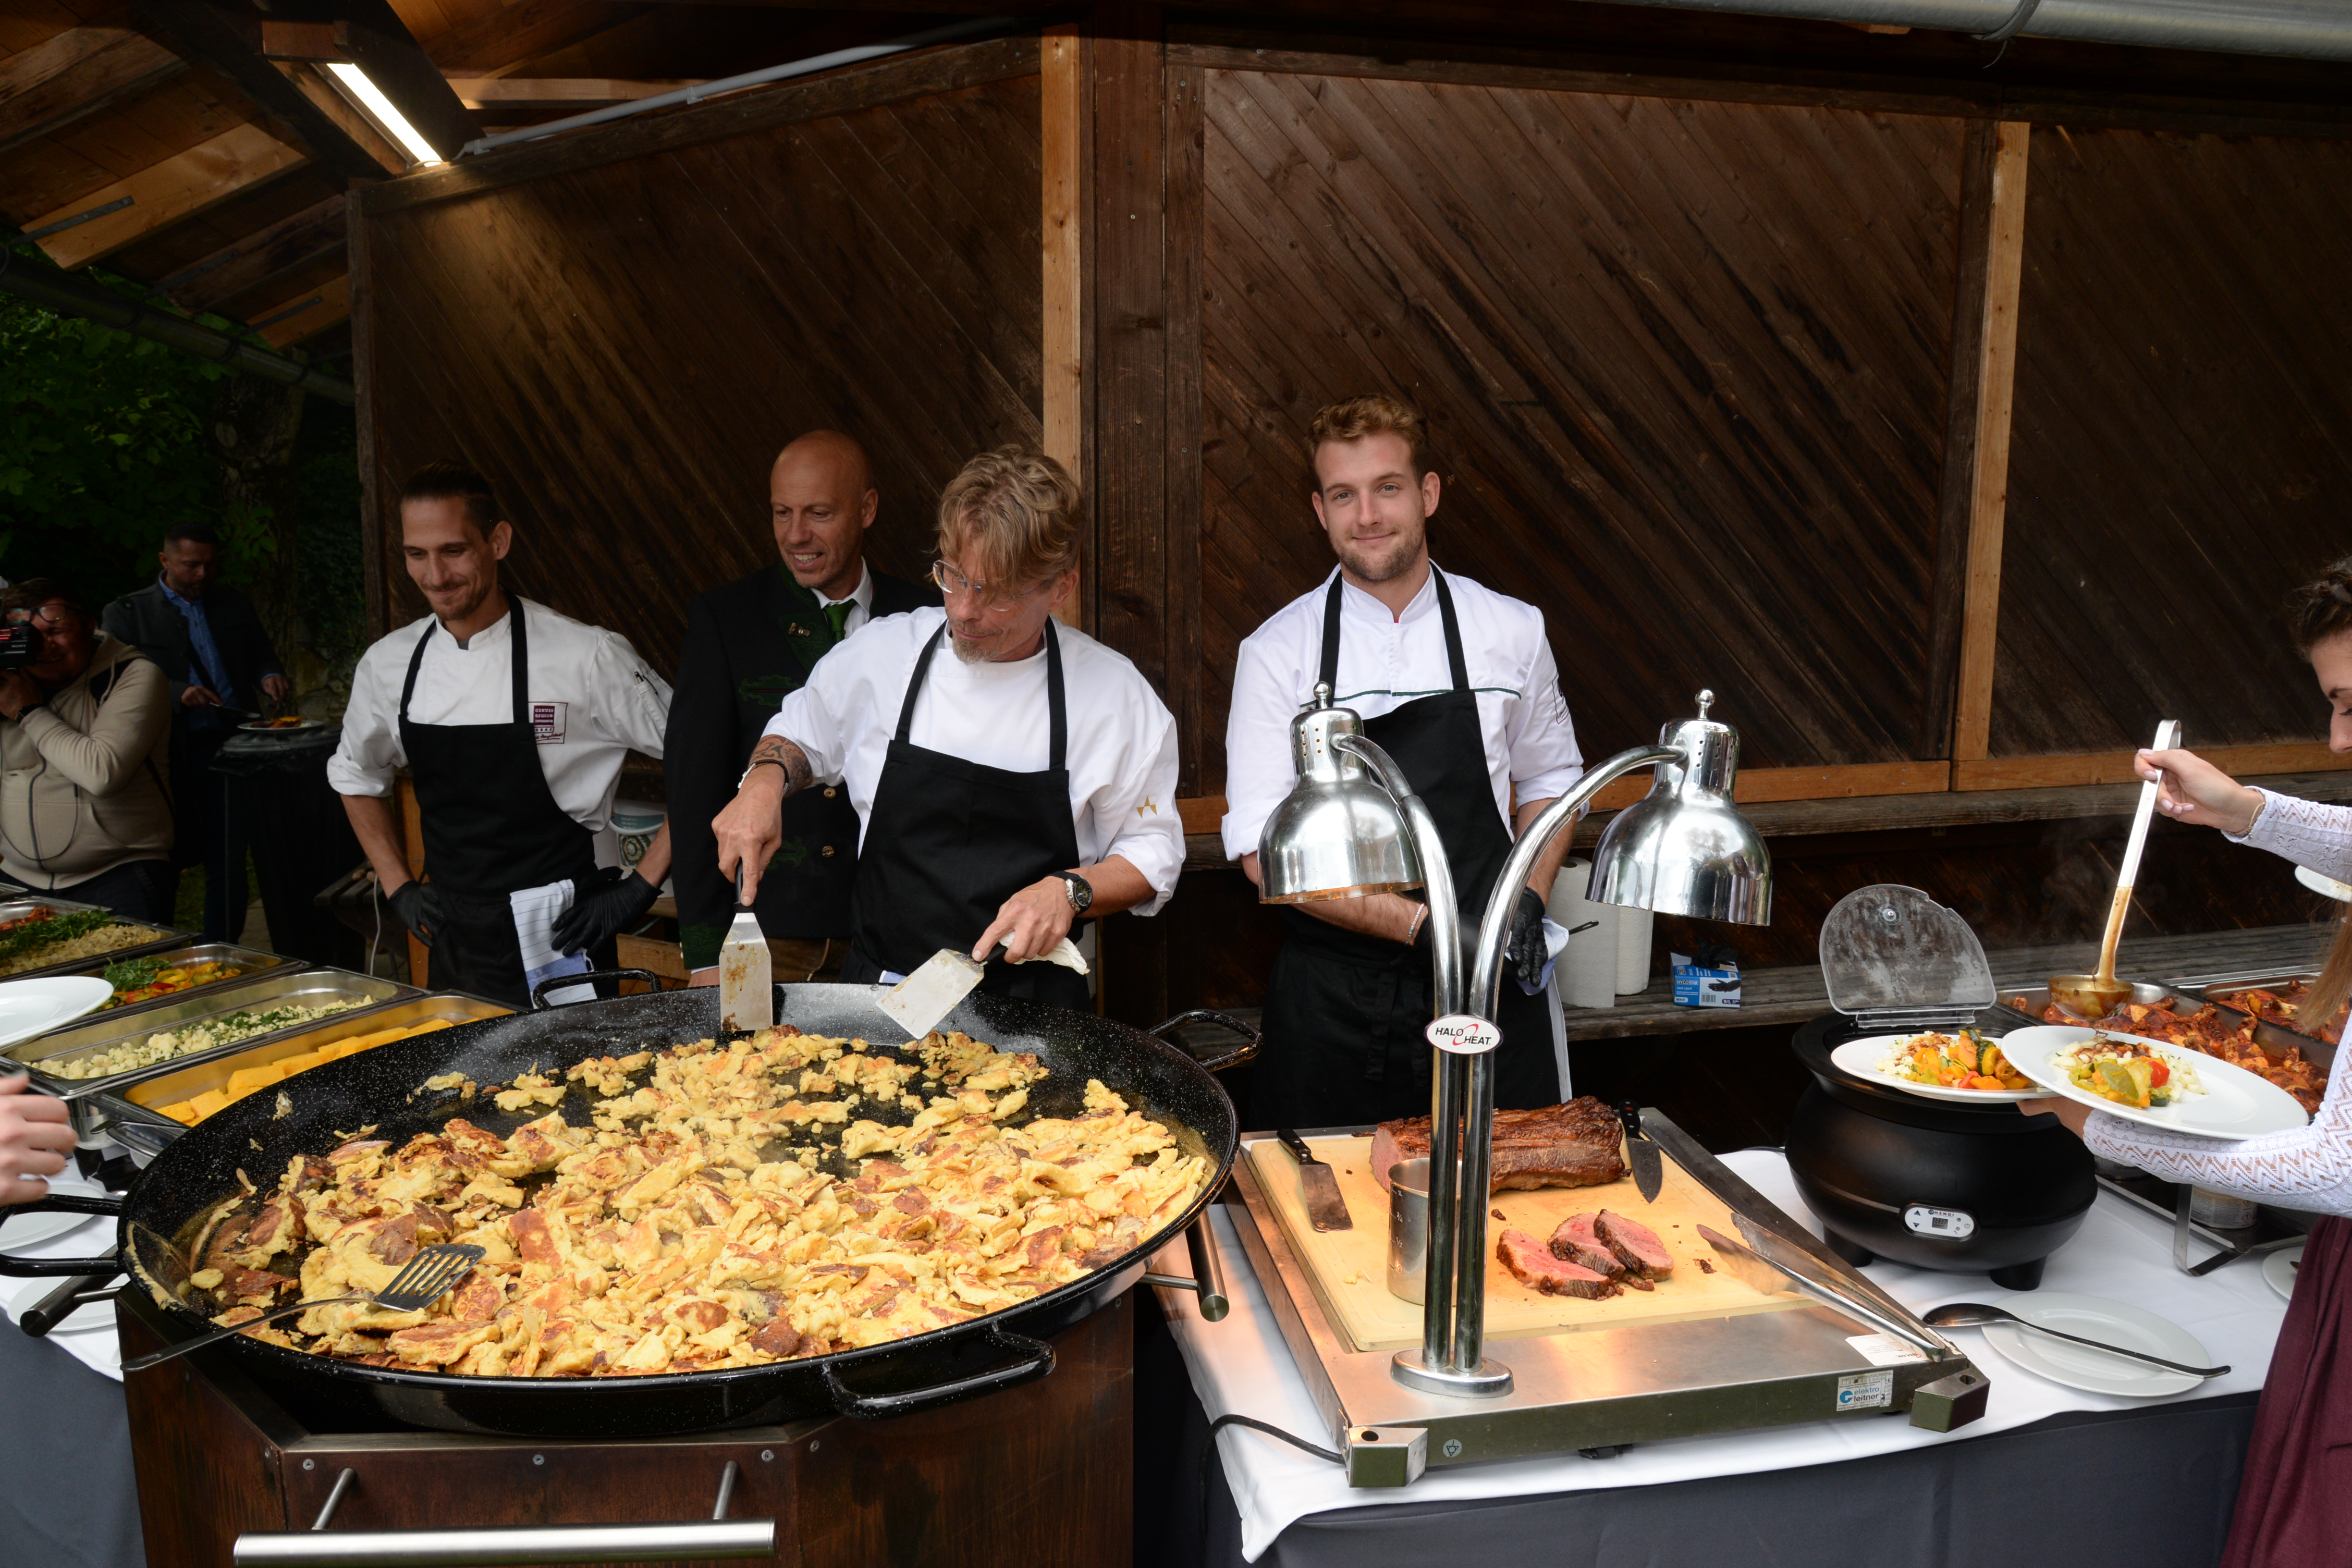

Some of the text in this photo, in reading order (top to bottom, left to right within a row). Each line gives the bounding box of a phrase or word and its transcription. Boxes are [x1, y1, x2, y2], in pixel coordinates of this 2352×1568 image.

[1435, 1027, 1464, 1036] HALO
[1463, 1036, 1492, 1045] HEAT
[1854, 1387, 1880, 1395] elektro
[1854, 1393, 1879, 1402] leitner
